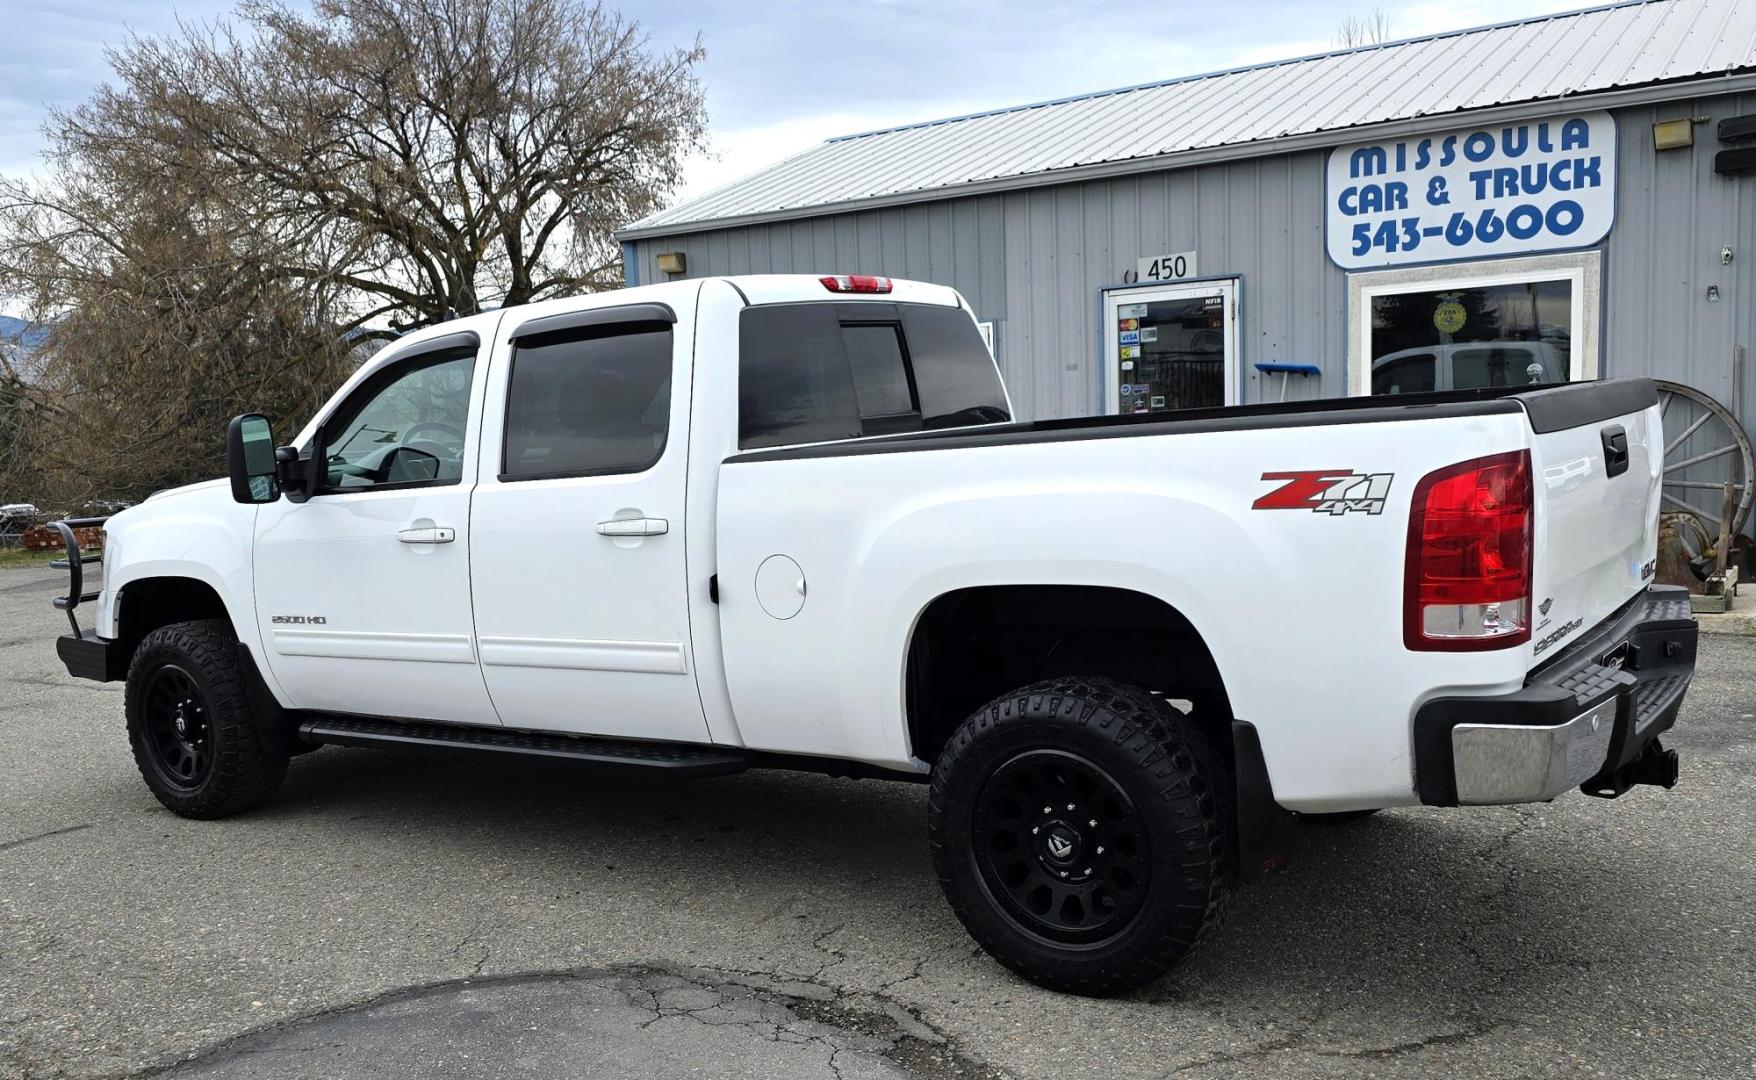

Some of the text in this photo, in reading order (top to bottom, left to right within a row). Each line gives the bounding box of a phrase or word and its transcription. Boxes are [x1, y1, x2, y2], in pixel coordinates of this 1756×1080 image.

[1350, 117, 1590, 179] MISSOULA
[1337, 156, 1602, 217] CAR & TRUCK
[1352, 199, 1585, 257] 543-6600
[1148, 255, 1187, 281] 450
[1121, 333, 1138, 341] VISA
[1251, 469, 1394, 510] Z71
[271, 615, 327, 625] 2500 HD
